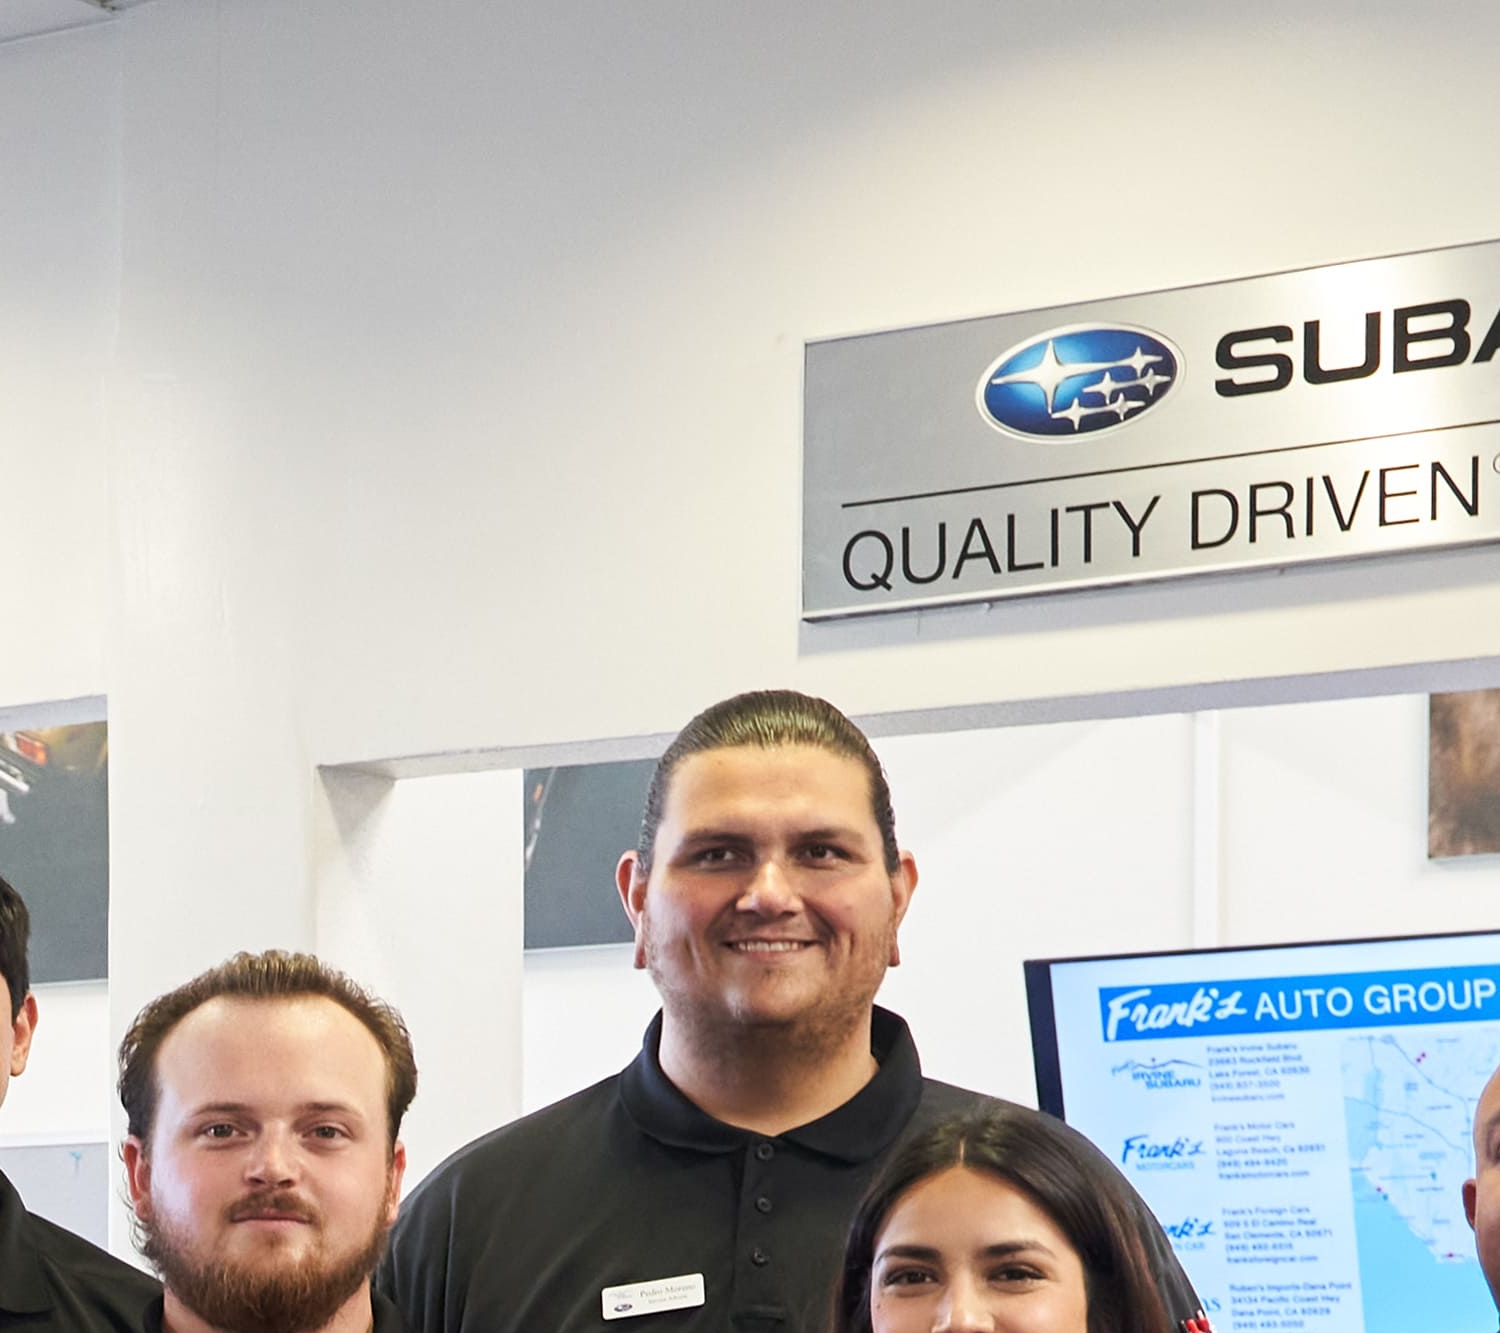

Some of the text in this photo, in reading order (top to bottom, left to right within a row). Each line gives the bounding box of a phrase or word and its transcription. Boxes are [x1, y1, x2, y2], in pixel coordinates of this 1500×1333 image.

[842, 495, 1161, 592] QUALITY
[1106, 988, 1247, 1041] Frank's
[1254, 987, 1353, 1021] AUTO
[1363, 978, 1497, 1015] GROUP
[1122, 1134, 1207, 1164] Frank's
